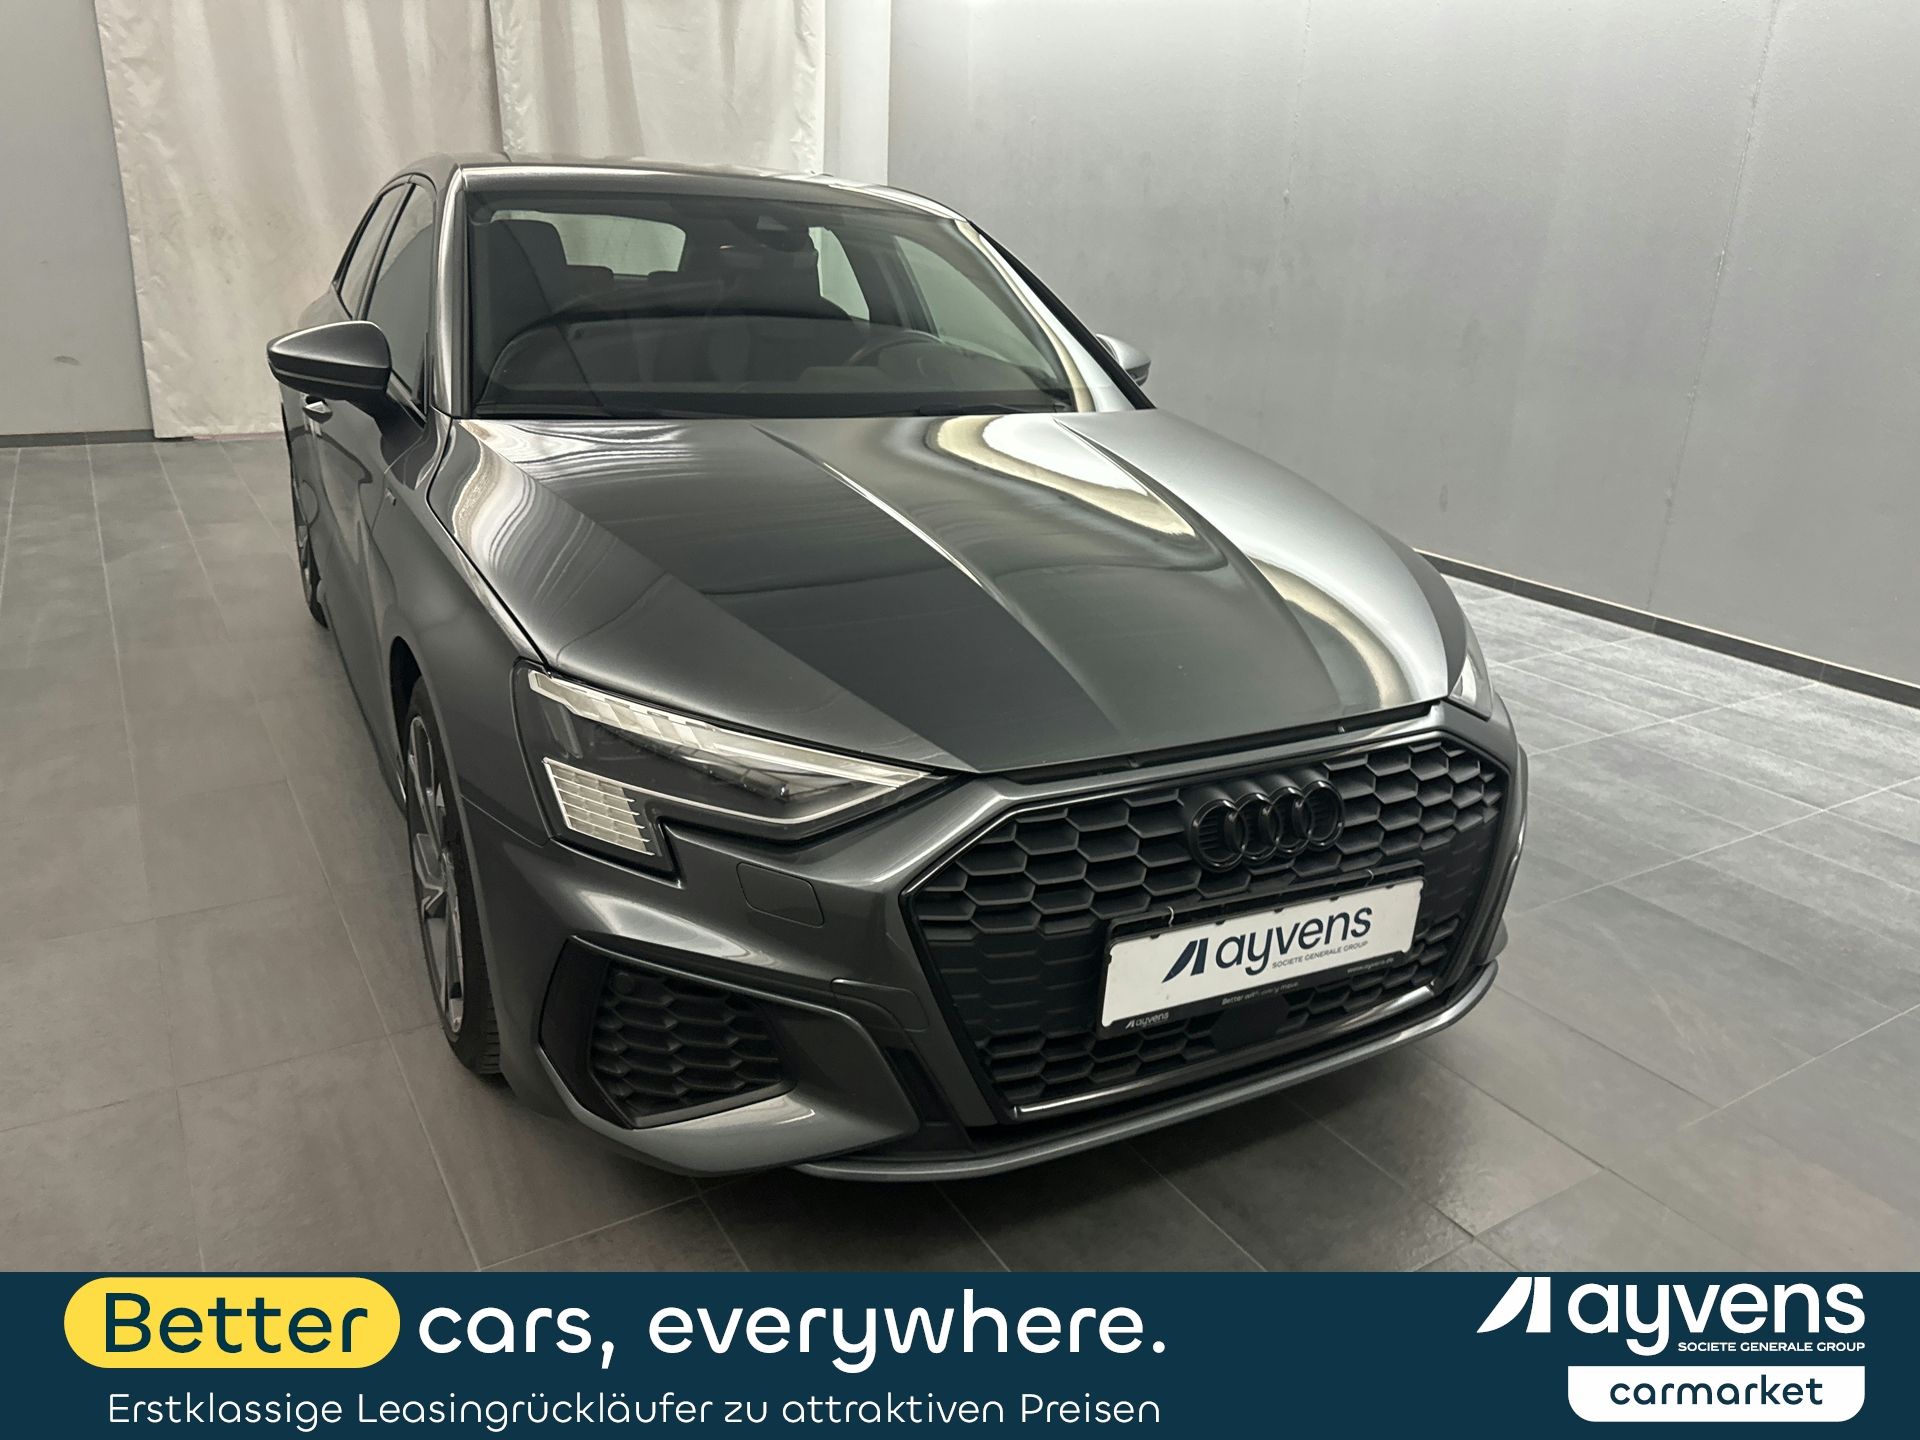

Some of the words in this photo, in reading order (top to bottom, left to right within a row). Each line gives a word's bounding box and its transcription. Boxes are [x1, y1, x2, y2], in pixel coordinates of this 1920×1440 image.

[1215, 907, 1373, 976] ayvens
[1272, 955, 1303, 969] SOCIETE
[1304, 946, 1342, 961] GENERALE
[1343, 940, 1369, 952] GROUP
[1135, 1011, 1169, 1028] ayvens
